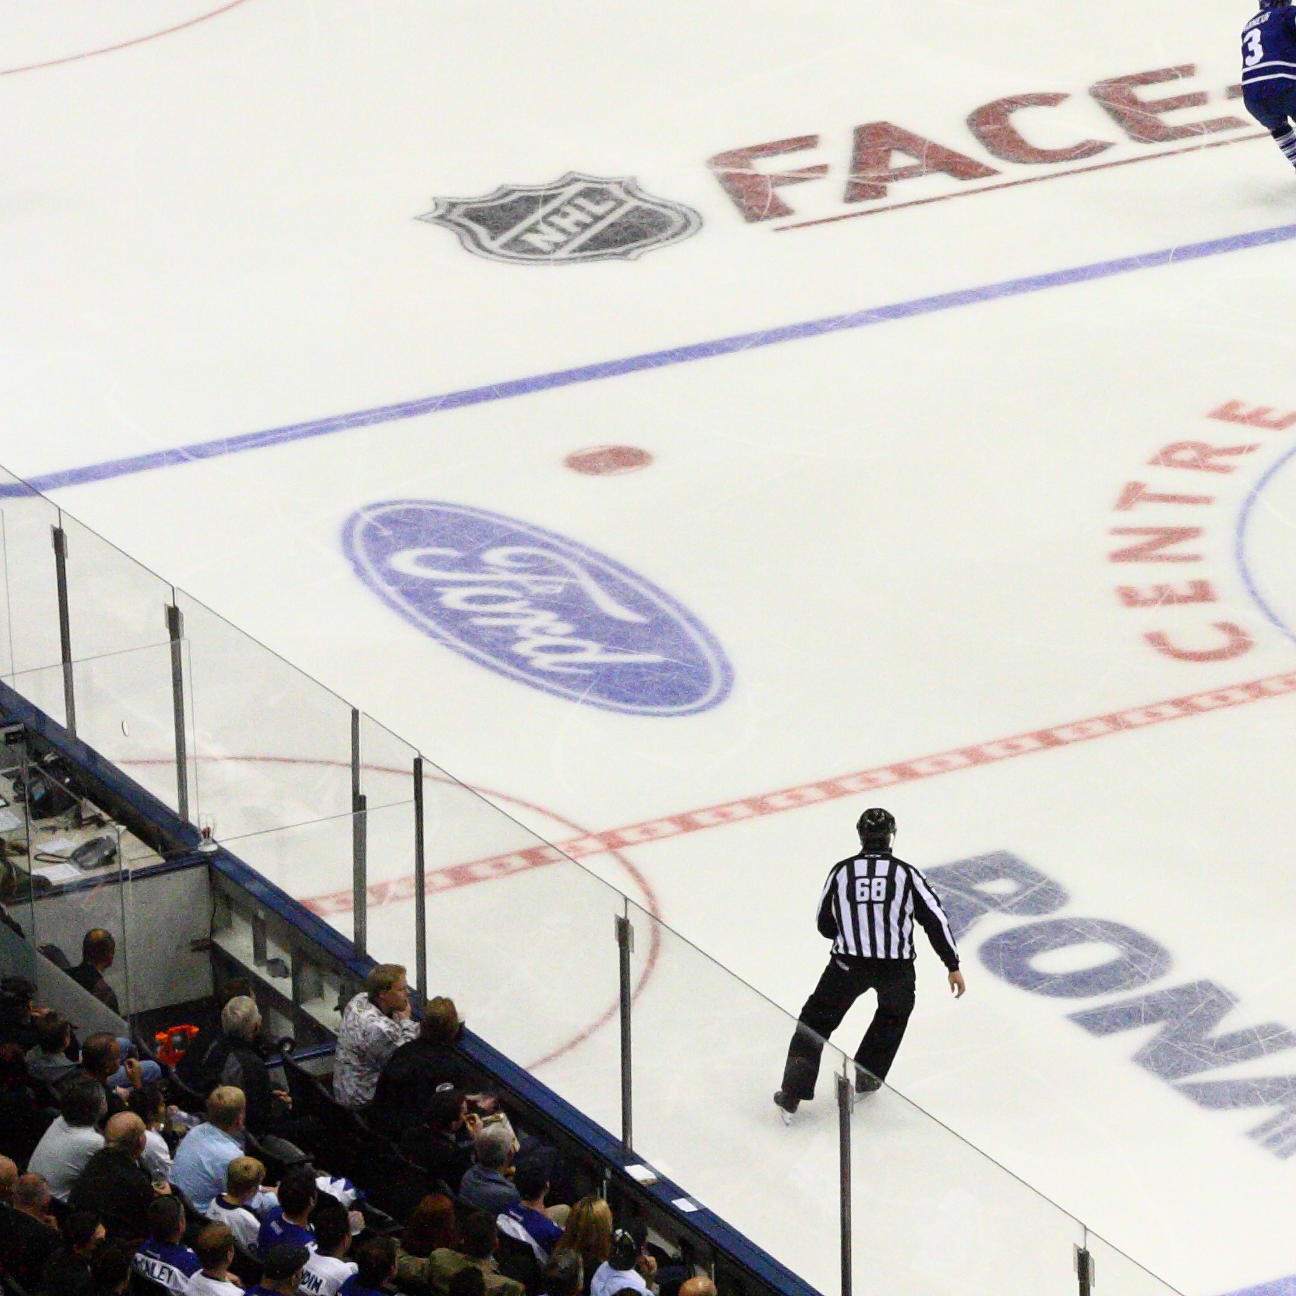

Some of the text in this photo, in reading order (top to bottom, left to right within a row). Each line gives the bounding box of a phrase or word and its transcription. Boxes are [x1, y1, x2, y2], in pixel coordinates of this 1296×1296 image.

[1243, 27, 1264, 67] 3
[519, 188, 620, 253] NHL
[388, 542, 682, 676] Ford
[855, 877, 887, 902] 68
